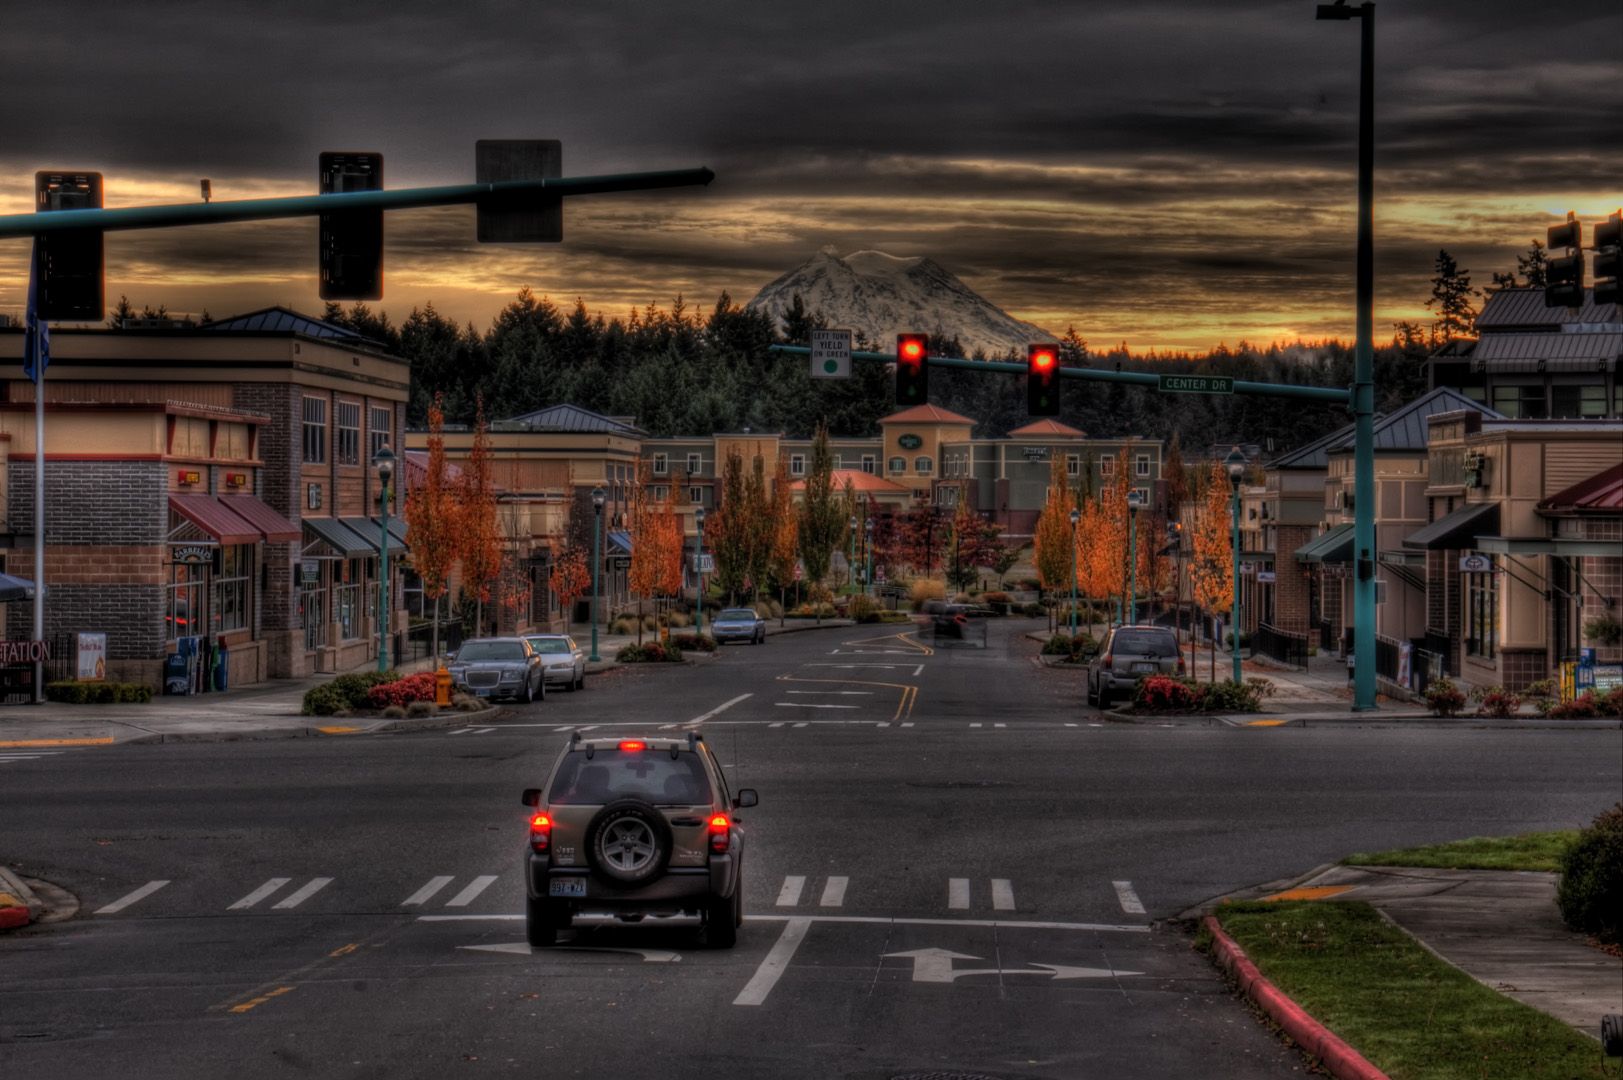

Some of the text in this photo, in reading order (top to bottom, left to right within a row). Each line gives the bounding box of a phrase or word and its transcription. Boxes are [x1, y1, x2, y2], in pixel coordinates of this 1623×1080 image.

[814, 332, 849, 340] LEFT TURN
[820, 341, 843, 349] YIELD
[827, 350, 848, 358] GREEN
[1166, 377, 1227, 391] CENTER DR
